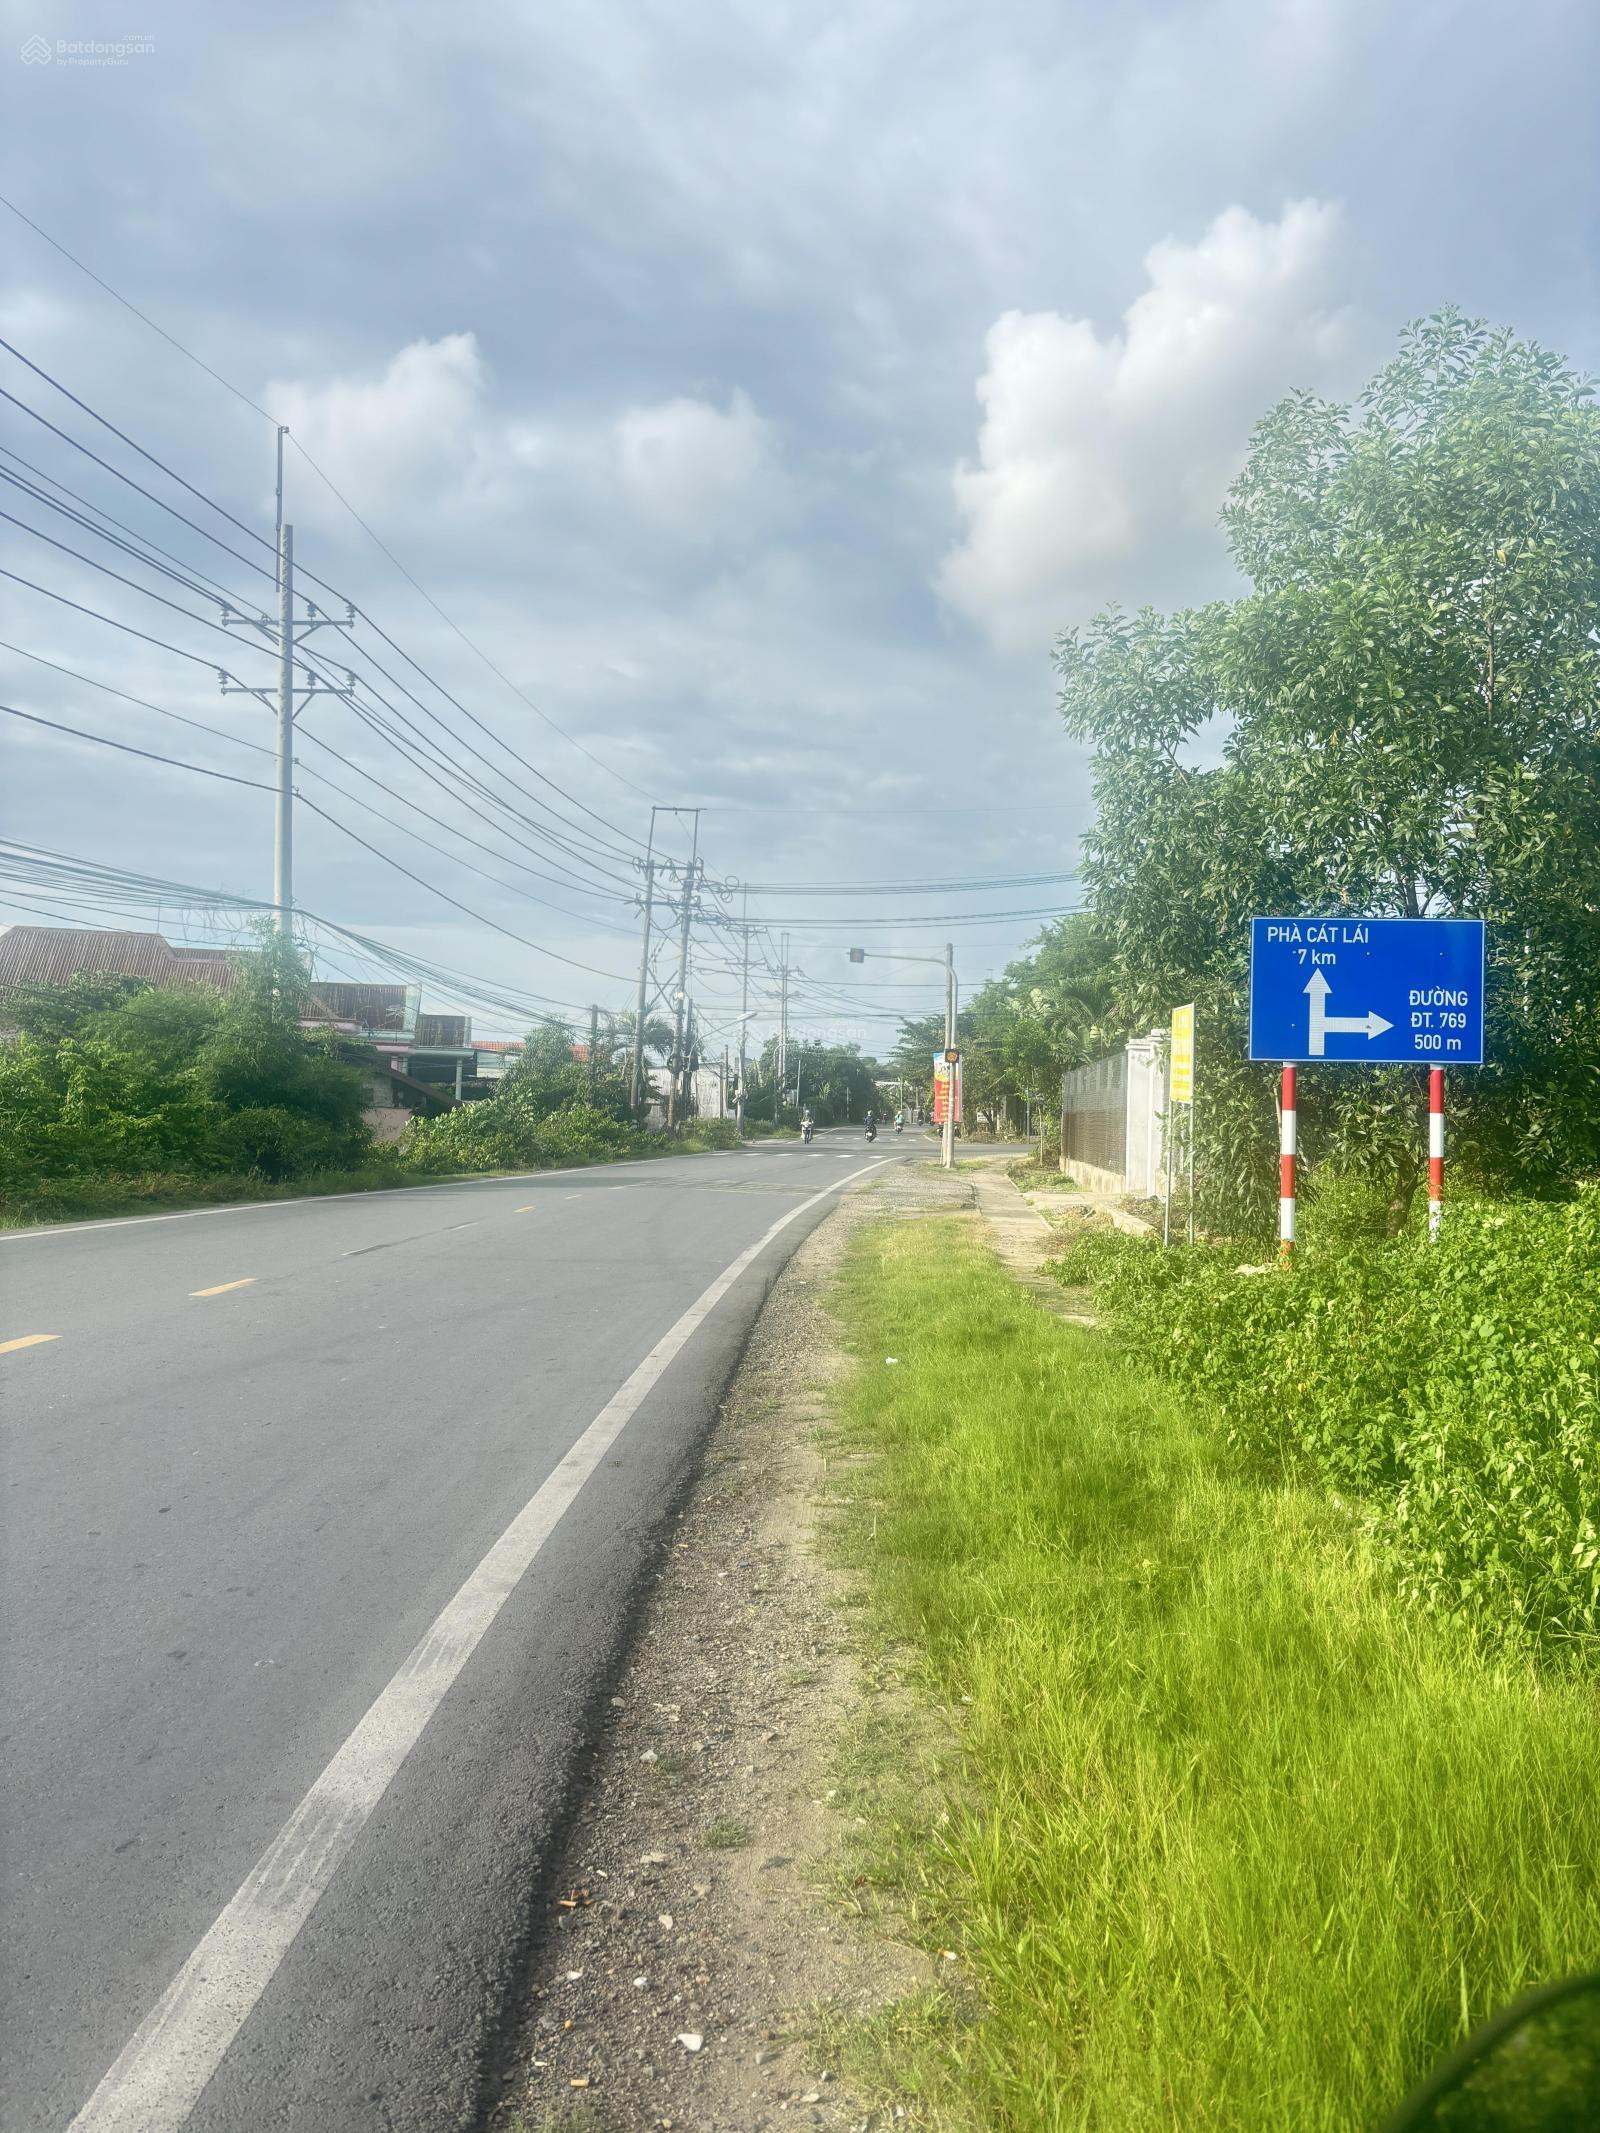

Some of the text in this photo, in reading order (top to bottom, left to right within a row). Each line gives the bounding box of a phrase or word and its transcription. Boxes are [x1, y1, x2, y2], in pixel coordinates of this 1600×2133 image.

[1267, 923, 1369, 944] PHÀ CÁT LÁI
[1298, 949, 1336, 965] 7 km
[1409, 986, 1468, 1006] ĐƯỜNG
[1411, 1012, 1466, 1029] ĐT. 769
[1415, 1034, 1461, 1050] 500 m
